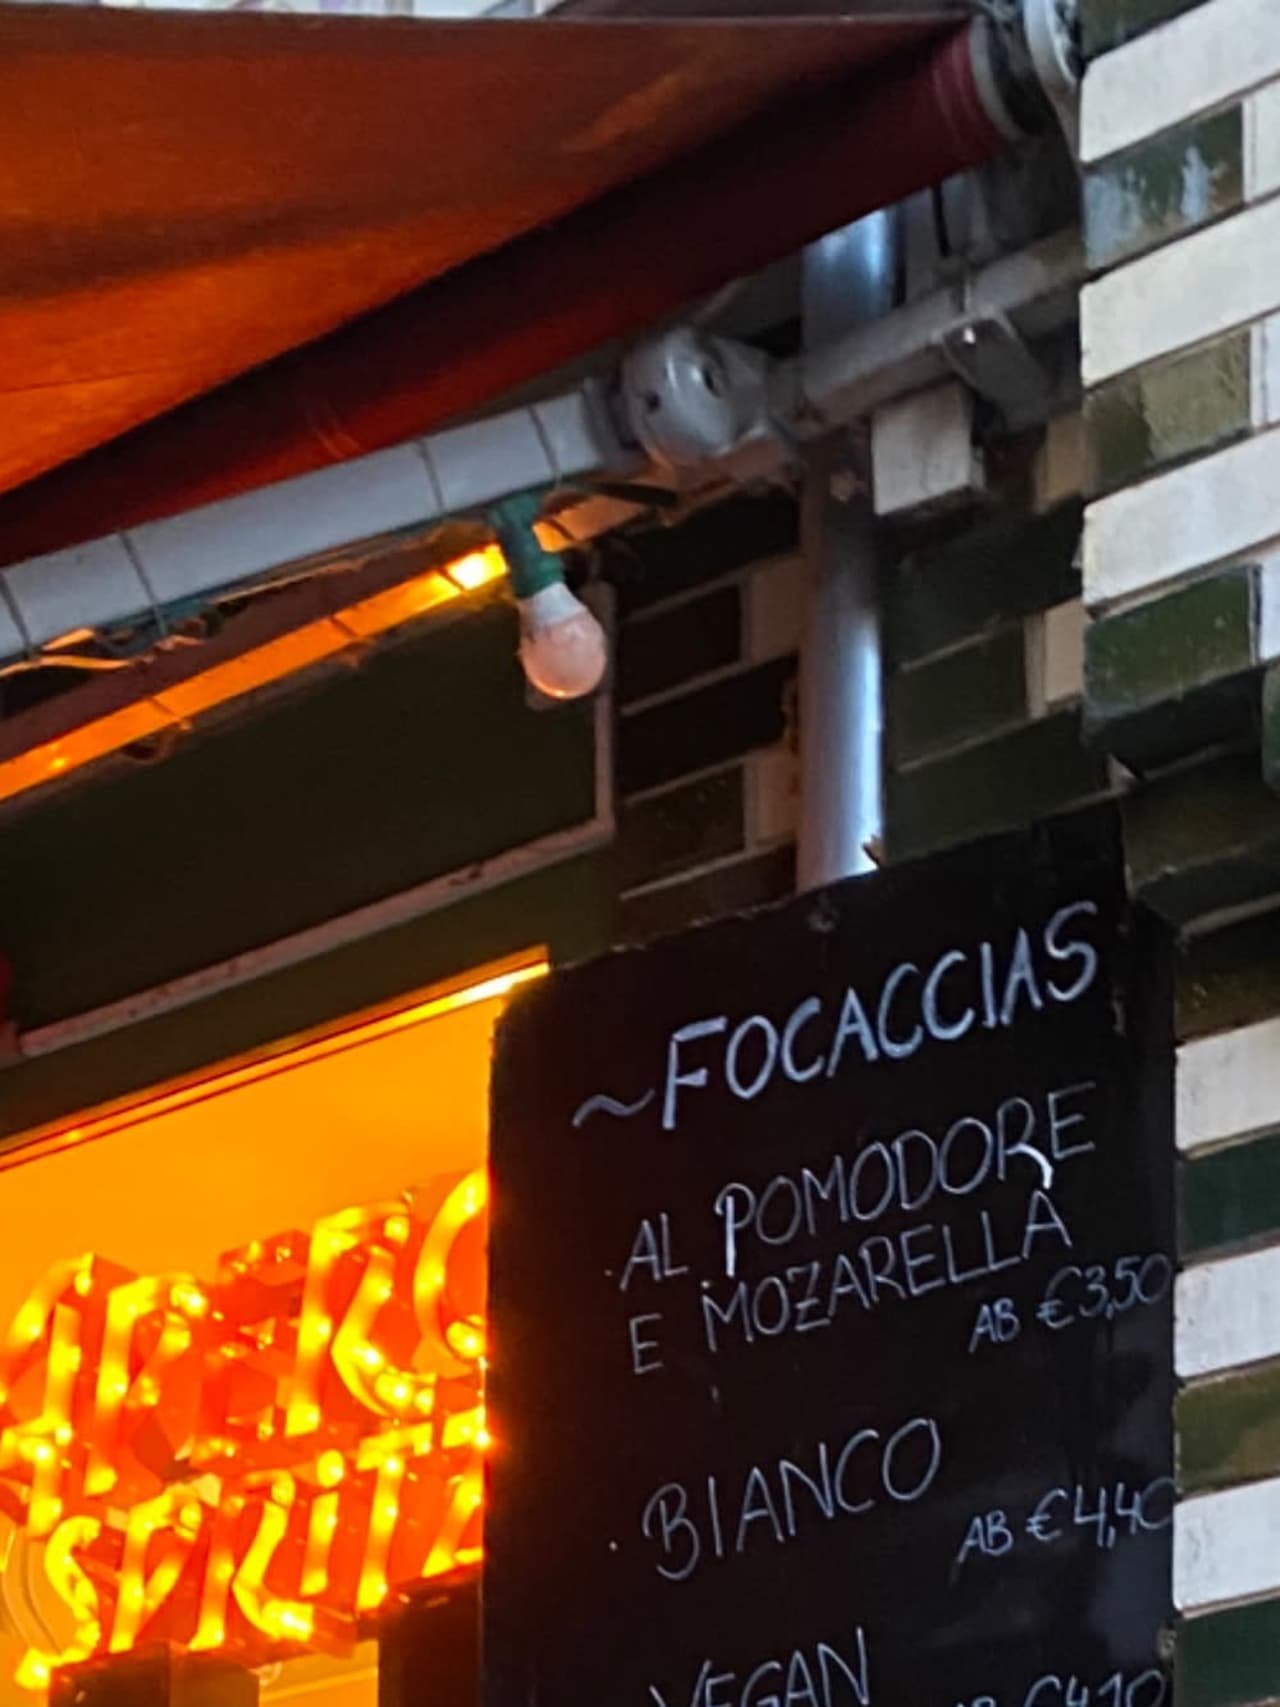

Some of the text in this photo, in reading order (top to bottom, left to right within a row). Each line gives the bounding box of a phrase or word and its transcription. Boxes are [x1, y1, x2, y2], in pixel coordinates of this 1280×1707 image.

[661, 901, 1099, 1130] FOCACCIAS
[618, 1082, 1097, 1289] AL POMODORE
[629, 1190, 1073, 1375] E MOZARELLA
[968, 1254, 1172, 1352] AB €3,50
[642, 1419, 941, 1581] BIANCO
[956, 1508, 1015, 1566] AB
